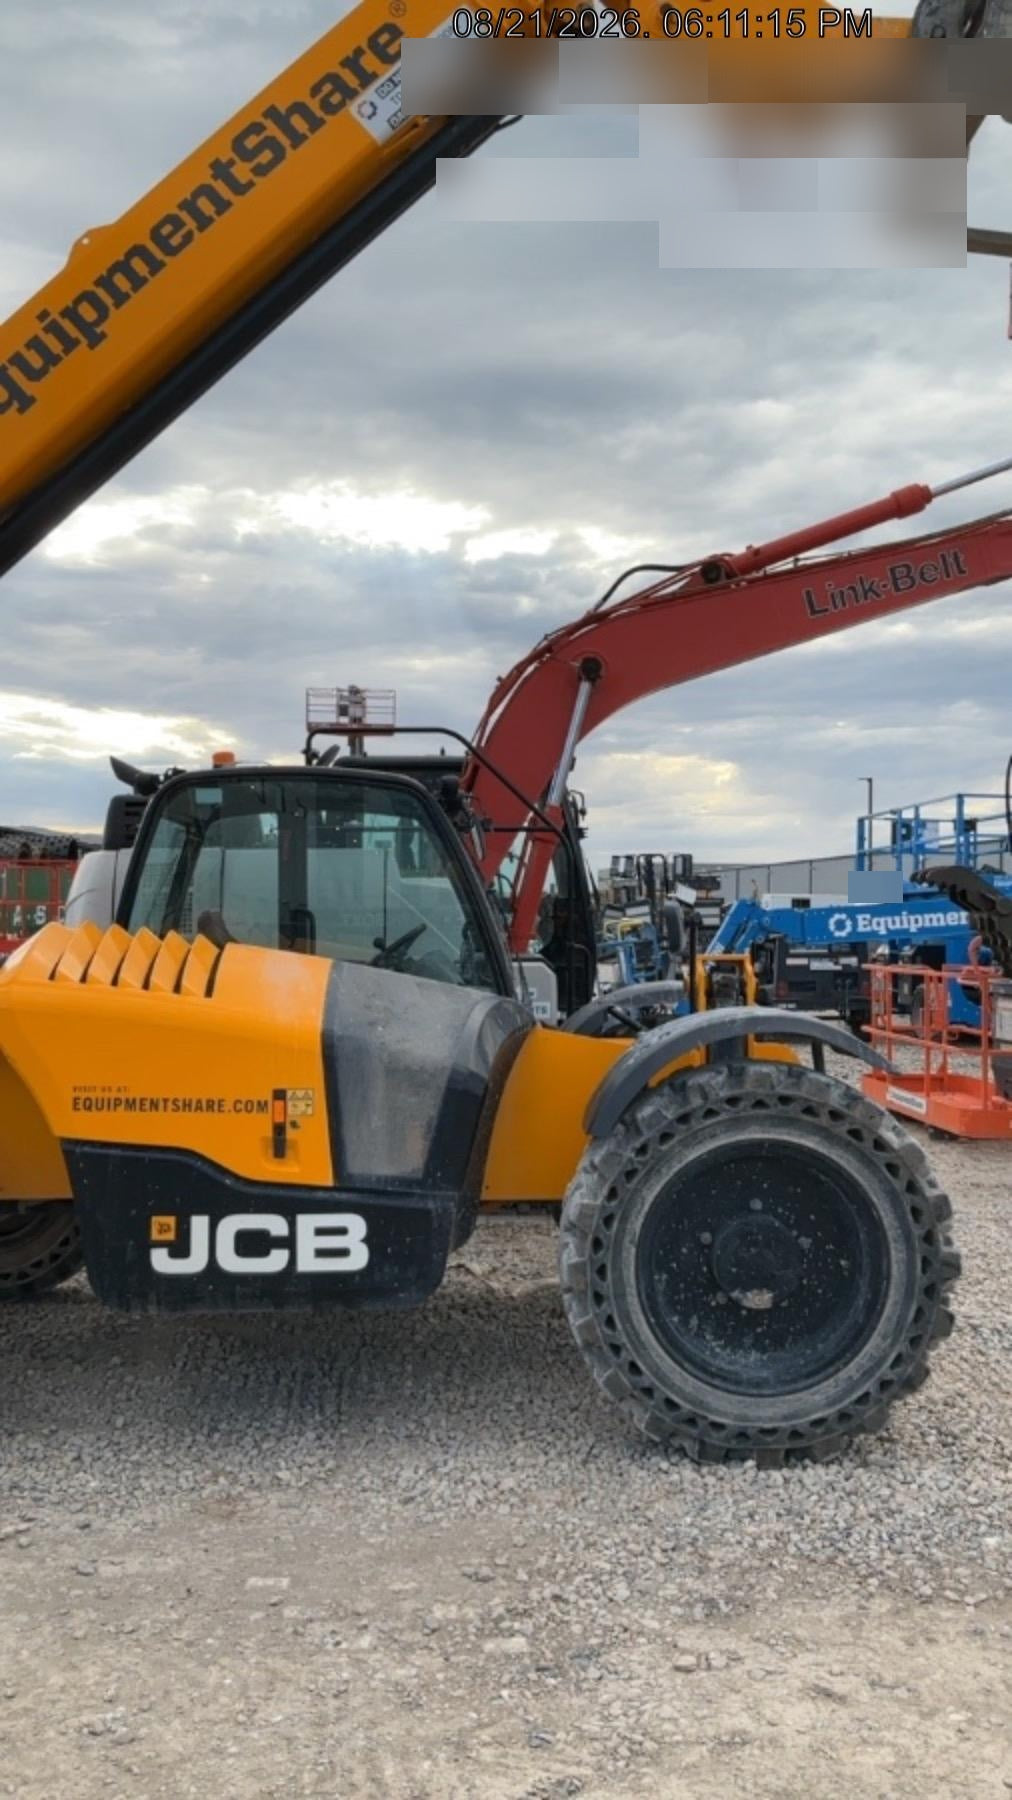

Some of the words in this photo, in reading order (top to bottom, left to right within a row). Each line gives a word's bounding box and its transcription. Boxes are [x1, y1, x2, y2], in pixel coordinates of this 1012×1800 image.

[804, 550, 967, 618] Link-Belt
[72, 1096, 269, 1113] EQUIPMENTSHARE.COM
[150, 1213, 369, 1274] JCB
